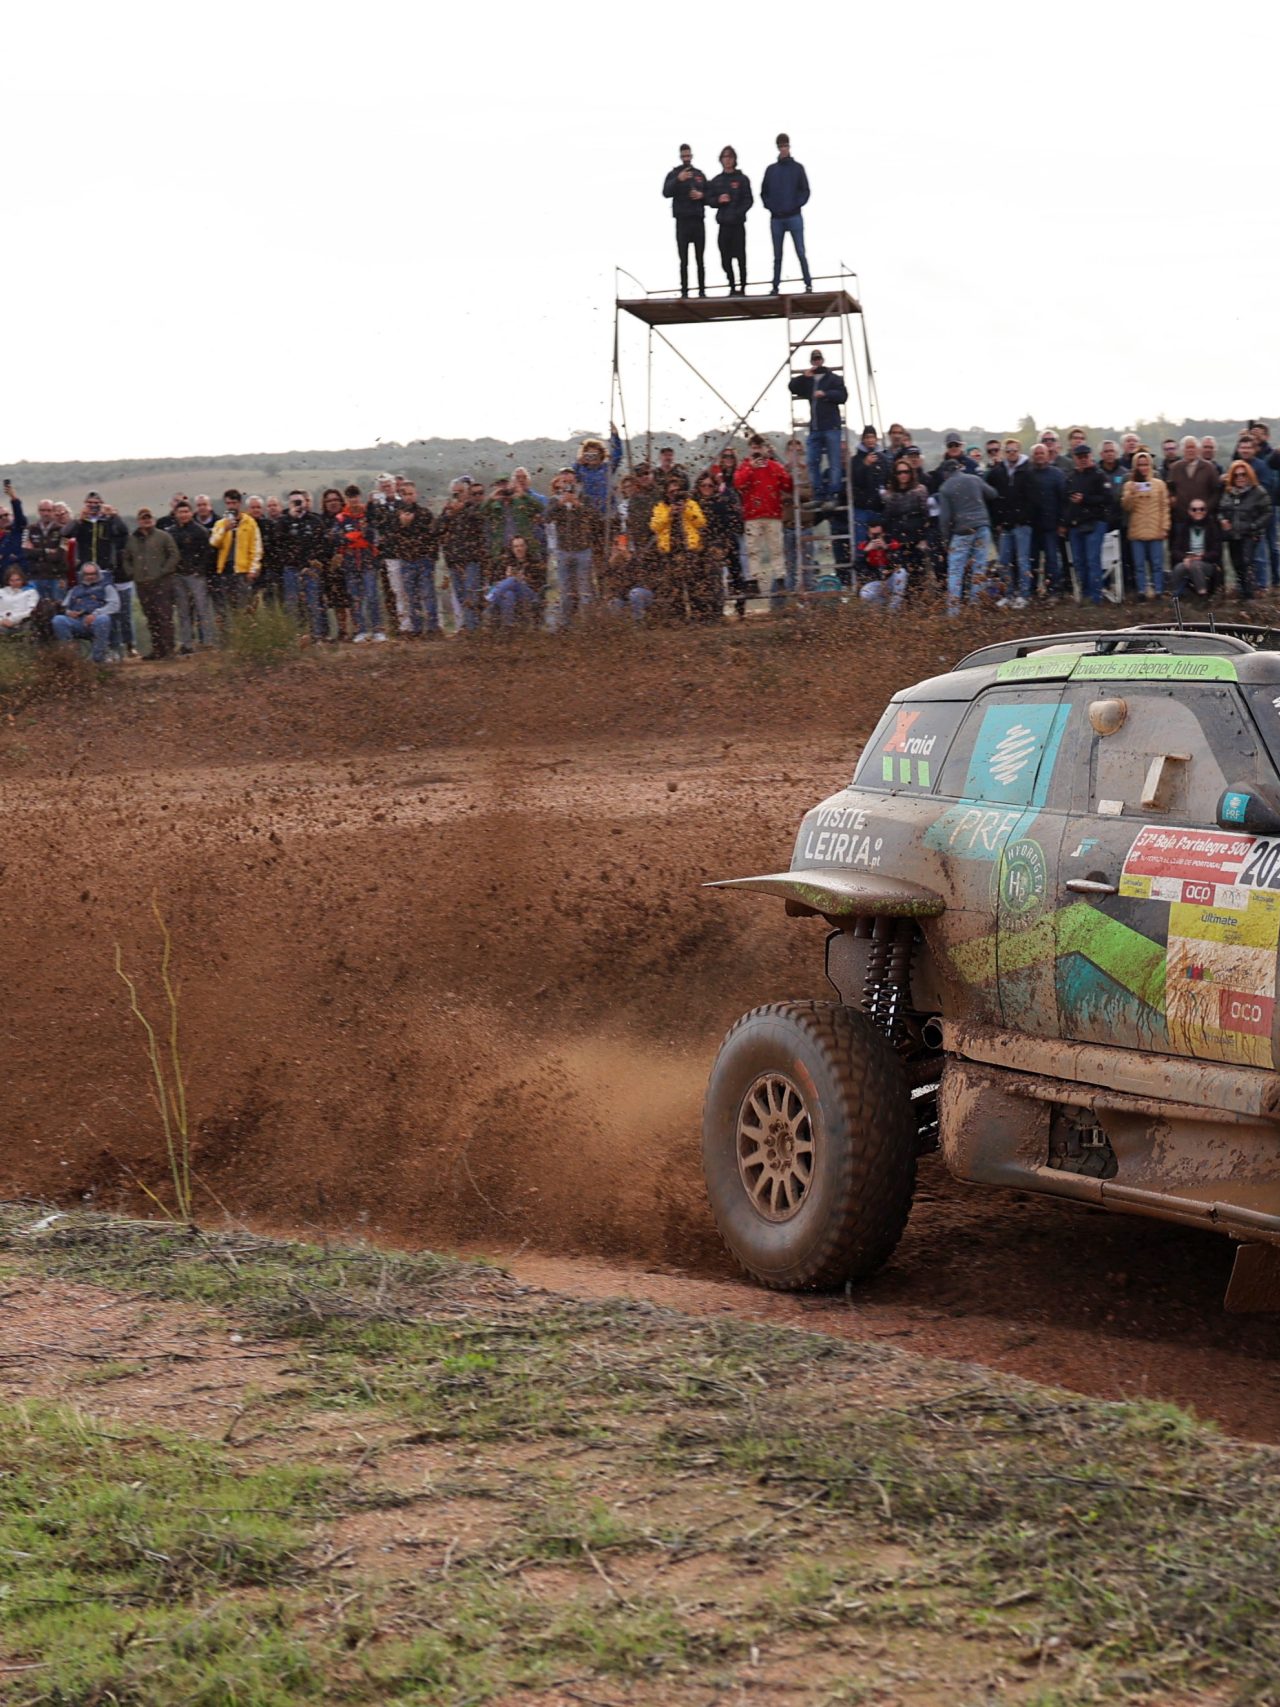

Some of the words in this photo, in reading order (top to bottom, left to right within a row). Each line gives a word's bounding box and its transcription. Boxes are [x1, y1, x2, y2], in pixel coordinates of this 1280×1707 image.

[1009, 663, 1037, 677] Move
[1074, 661, 1117, 675] towards
[1119, 663, 1126, 674] a
[1127, 661, 1171, 678] greener
[1172, 660, 1209, 676] future
[883, 711, 937, 756] X-raid
[816, 808, 872, 831] VISITE
[1225, 809, 1241, 819] PRF
[949, 809, 1023, 851] PRF
[804, 831, 871, 866] LEIRIA
[1155, 834, 1177, 852] Baja
[1175, 836, 1230, 857] Portalegre
[1227, 840, 1250, 856] 500
[1007, 844, 1043, 894] HYDROGEN
[1185, 884, 1210, 903] acp
[1201, 912, 1239, 927] ultimate
